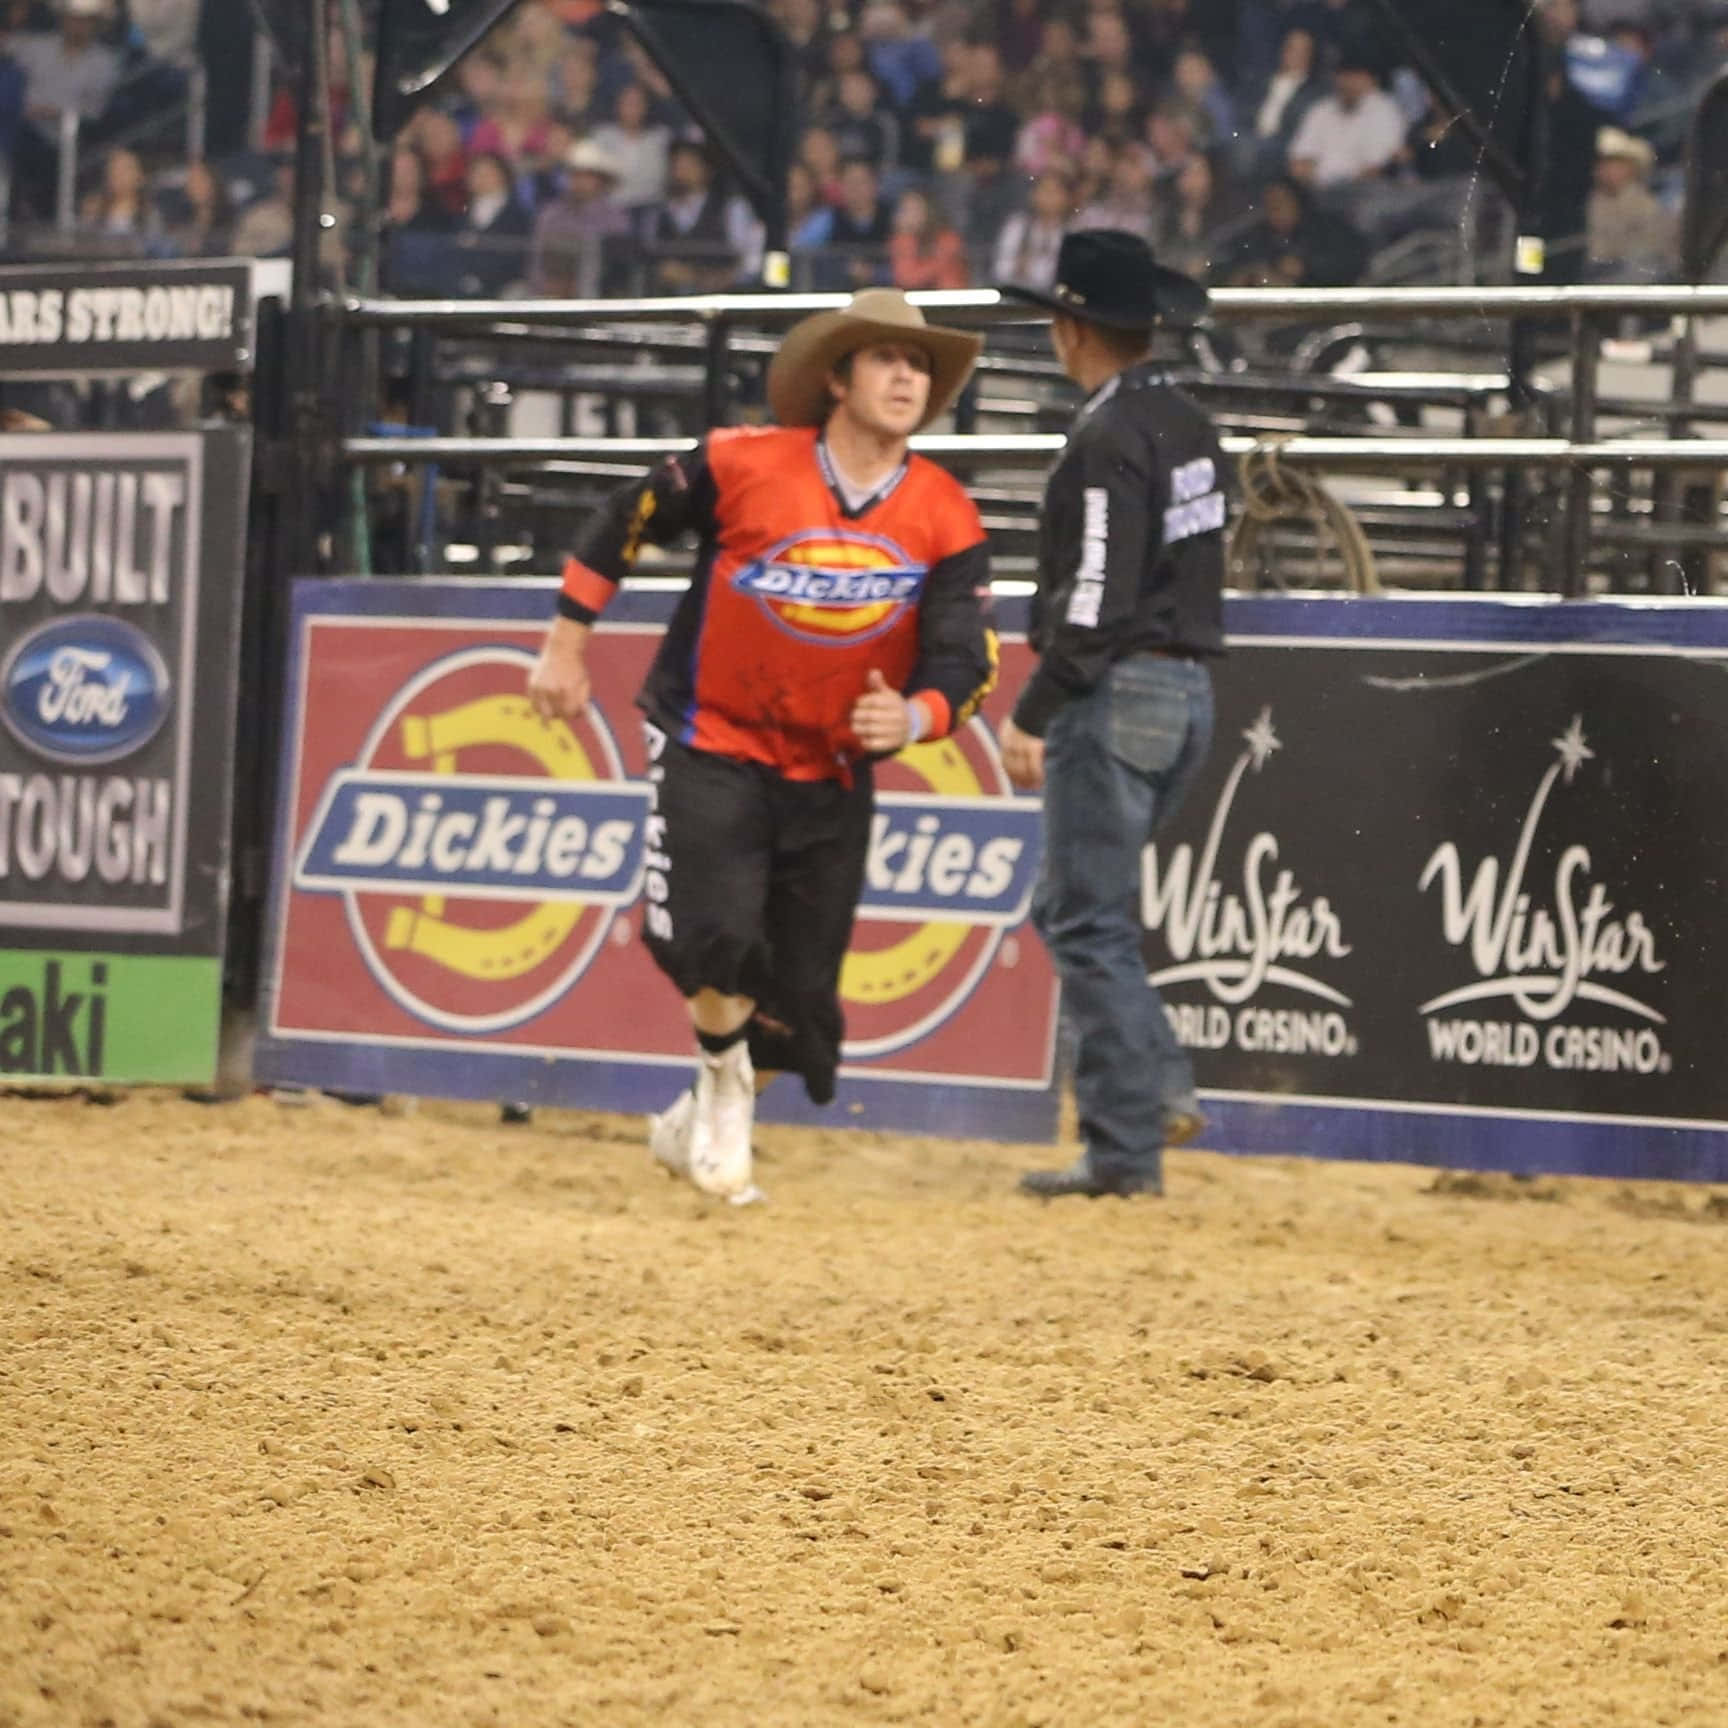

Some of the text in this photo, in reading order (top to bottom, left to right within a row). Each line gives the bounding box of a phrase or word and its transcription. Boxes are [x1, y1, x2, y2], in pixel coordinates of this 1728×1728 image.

[65, 285, 235, 341] STRONG!
[3, 471, 185, 605] BUILT
[38, 646, 128, 727] Ford
[334, 788, 636, 880] Dickies
[866, 814, 1025, 899] kies
[1418, 843, 1667, 1021] WinStar
[1162, 1003, 1347, 1057] RLD CASINO
[1429, 1016, 1662, 1073] WORLD CASINO
